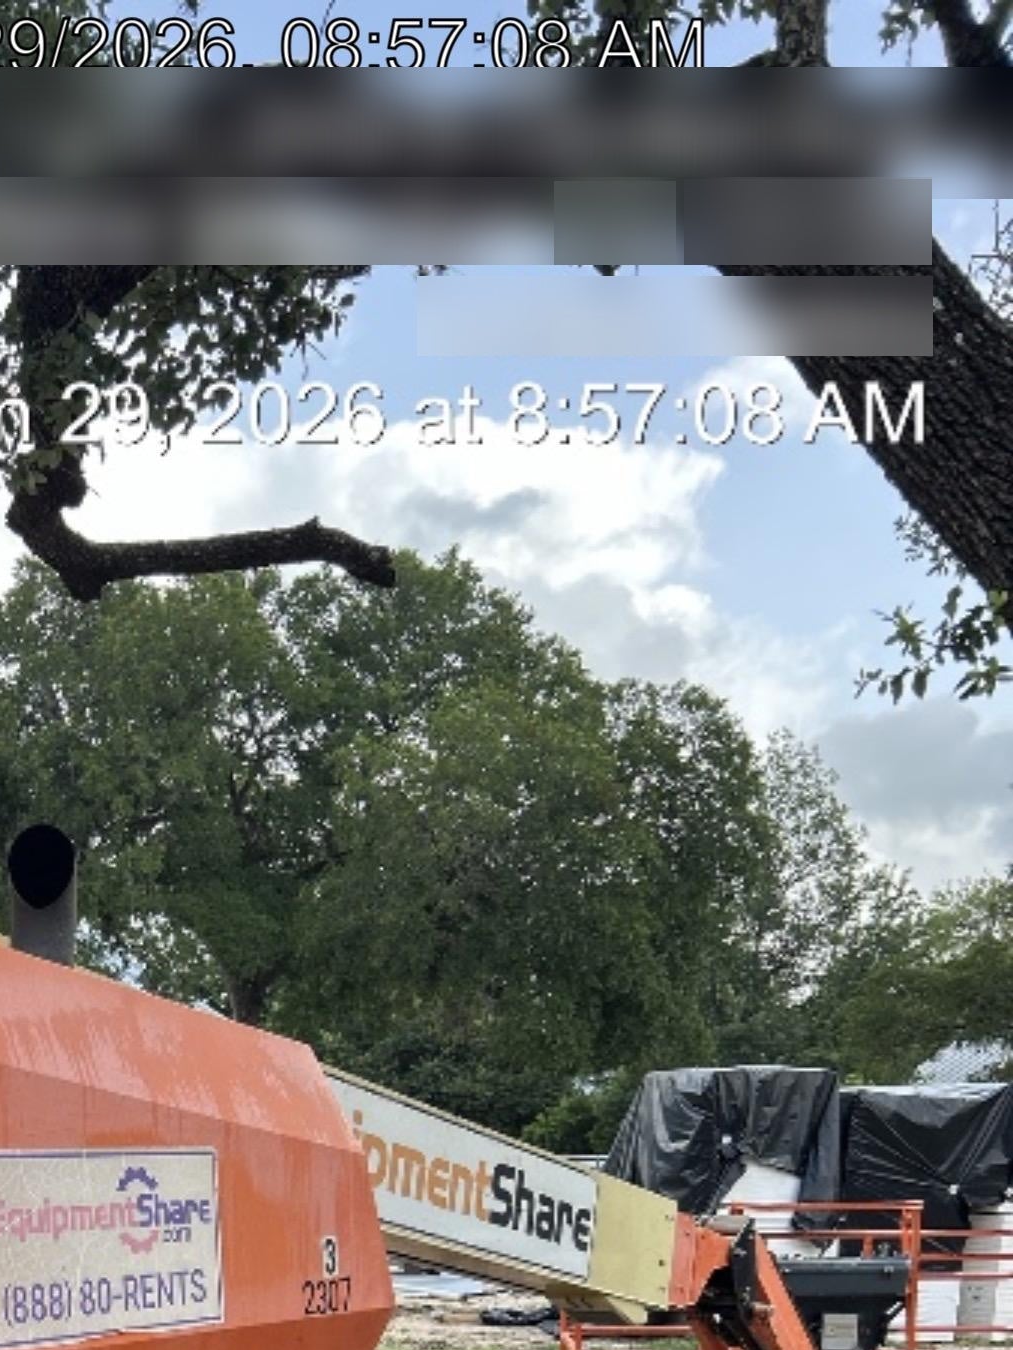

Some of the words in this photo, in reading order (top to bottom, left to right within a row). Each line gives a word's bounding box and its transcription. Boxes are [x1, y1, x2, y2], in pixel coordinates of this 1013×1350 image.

[324, 1238, 336, 1276] 3
[3, 1280, 72, 1327] (888)
[79, 1268, 207, 1316] 80-RENTS
[301, 1276, 351, 1315] 2307
